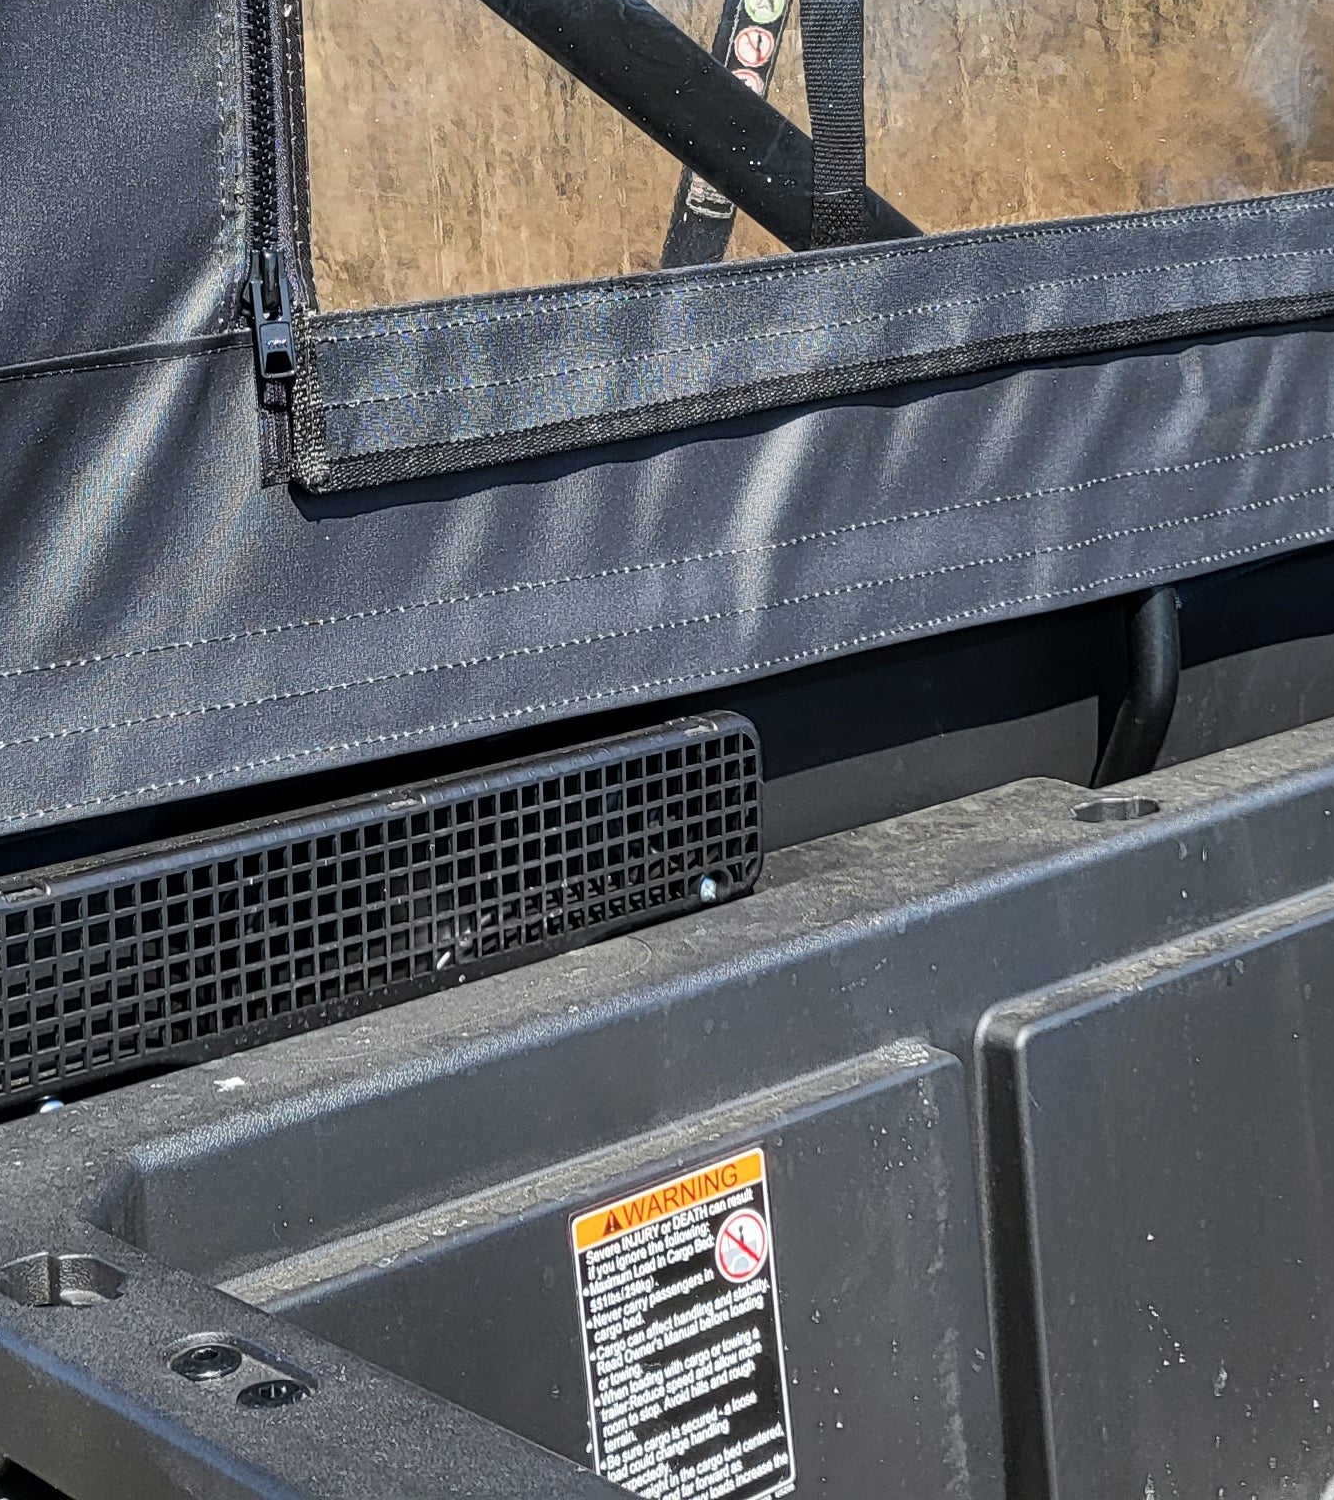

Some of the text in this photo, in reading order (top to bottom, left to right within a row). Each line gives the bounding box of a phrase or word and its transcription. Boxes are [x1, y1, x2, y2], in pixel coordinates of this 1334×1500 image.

[586, 1187, 754, 1265] Severe INJURY or DEATH can result
[622, 1163, 738, 1226] WARNING
[587, 1264, 596, 1281] if
[596, 1259, 616, 1280] you
[615, 1247, 647, 1271] ignore
[647, 1240, 664, 1256] the
[589, 1269, 633, 1297] Maximum
[633, 1257, 657, 1278] Load
[656, 1254, 667, 1269] in
[666, 1244, 694, 1264] Cargo
[592, 1268, 715, 1329] Never carry passengers in
[596, 1338, 627, 1364] Cargo
[626, 1330, 646, 1348] can
[646, 1316, 674, 1340] affect
[673, 1301, 714, 1328] handling
[714, 1290, 733, 1310] and
[594, 1322, 623, 1343] cargo
[596, 1352, 624, 1376] Read
[663, 1319, 699, 1347] Manual
[699, 1309, 730, 1331] before
[729, 1292, 764, 1318] loading
[598, 1376, 610, 1391] or
[600, 1327, 760, 1406] When loading with cargo or towing a
[602, 1417, 629, 1438] room
[628, 1412, 639, 1427] to
[663, 1387, 691, 1411] Avoid
[690, 1380, 710, 1398] hills
[710, 1369, 729, 1390] and
[728, 1358, 756, 1381] rough
[665, 1368, 695, 1397] speed
[695, 1360, 714, 1381] and
[713, 1351, 738, 1372] allow
[738, 1341, 762, 1361] more
[606, 1454, 621, 1470] Be
[621, 1444, 643, 1463] sure
[643, 1431, 671, 1456] cargo
[671, 1426, 681, 1440] is
[680, 1406, 718, 1436] secured
[724, 1403, 732, 1416] a
[731, 1391, 757, 1412] loose
[607, 1418, 730, 1483] load could change handling
